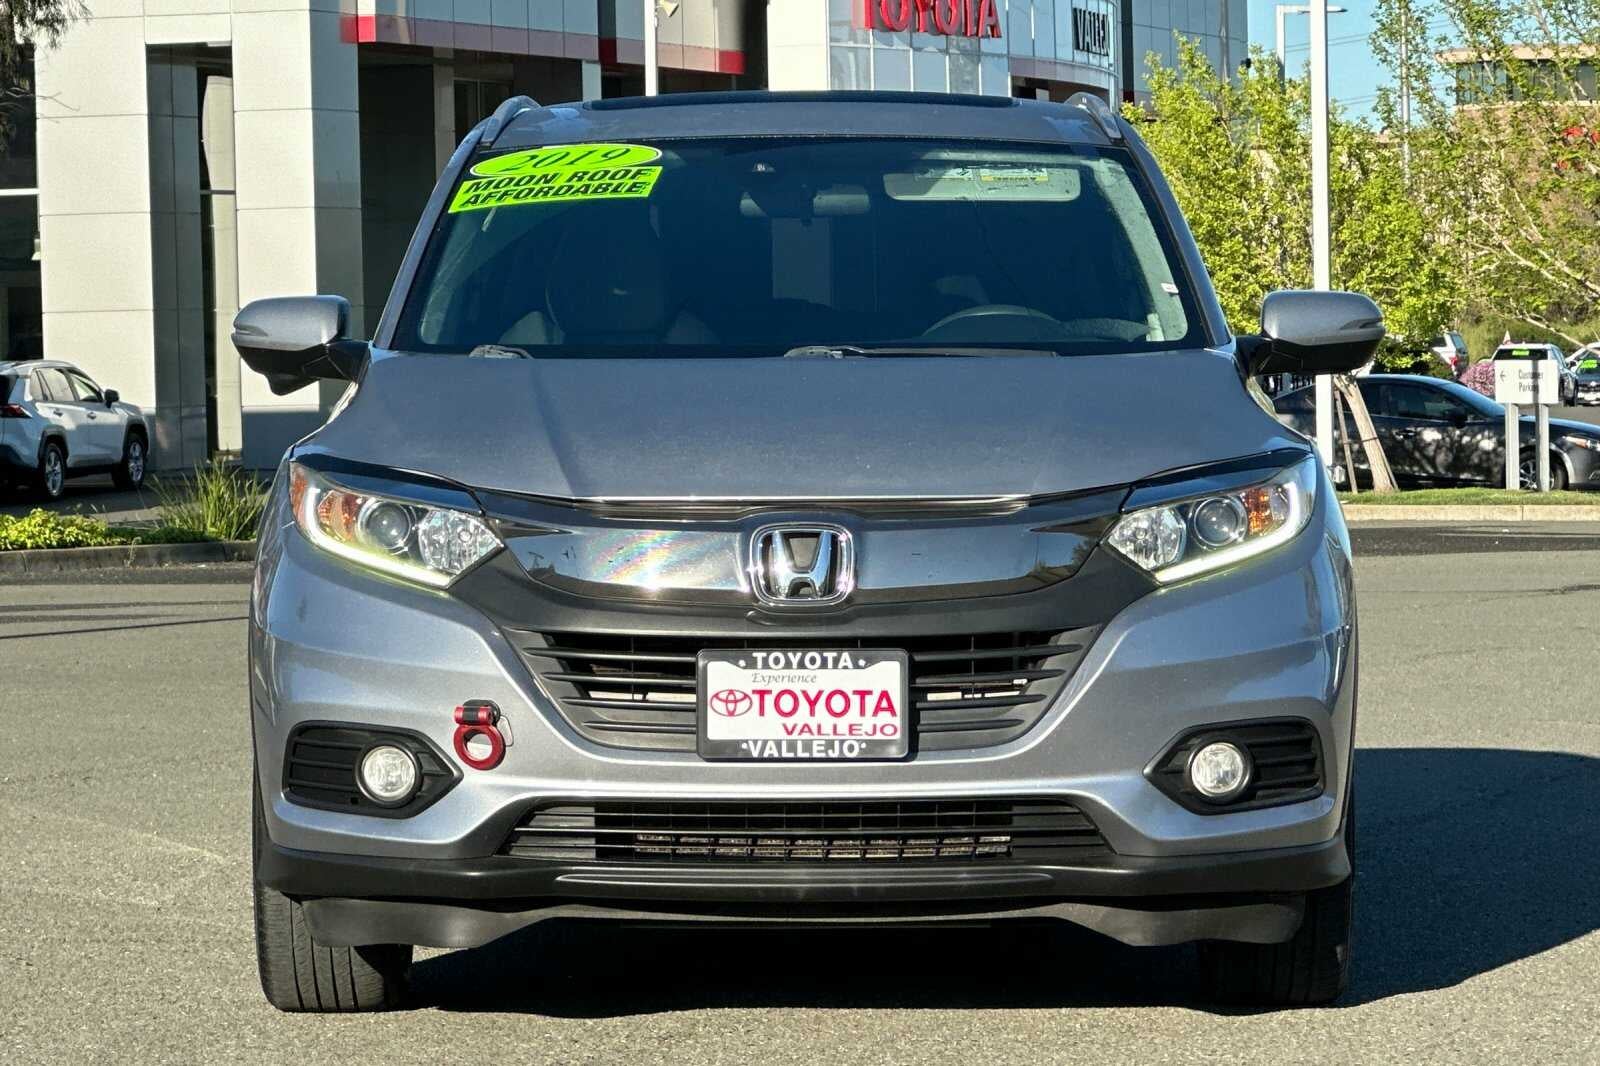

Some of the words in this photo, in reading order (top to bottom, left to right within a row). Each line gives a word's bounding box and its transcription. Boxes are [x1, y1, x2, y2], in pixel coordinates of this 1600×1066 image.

[499, 147, 632, 172] 2019
[464, 170, 557, 194] MOON
[566, 167, 652, 184] ROOF
[459, 181, 652, 207] AFFORDABLE
[752, 651, 854, 669] TOYOTA
[751, 672, 817, 686] Experience
[751, 689, 898, 718] TOYOTA
[782, 723, 898, 737] VALLEJO
[748, 740, 860, 758] VALLEJO
